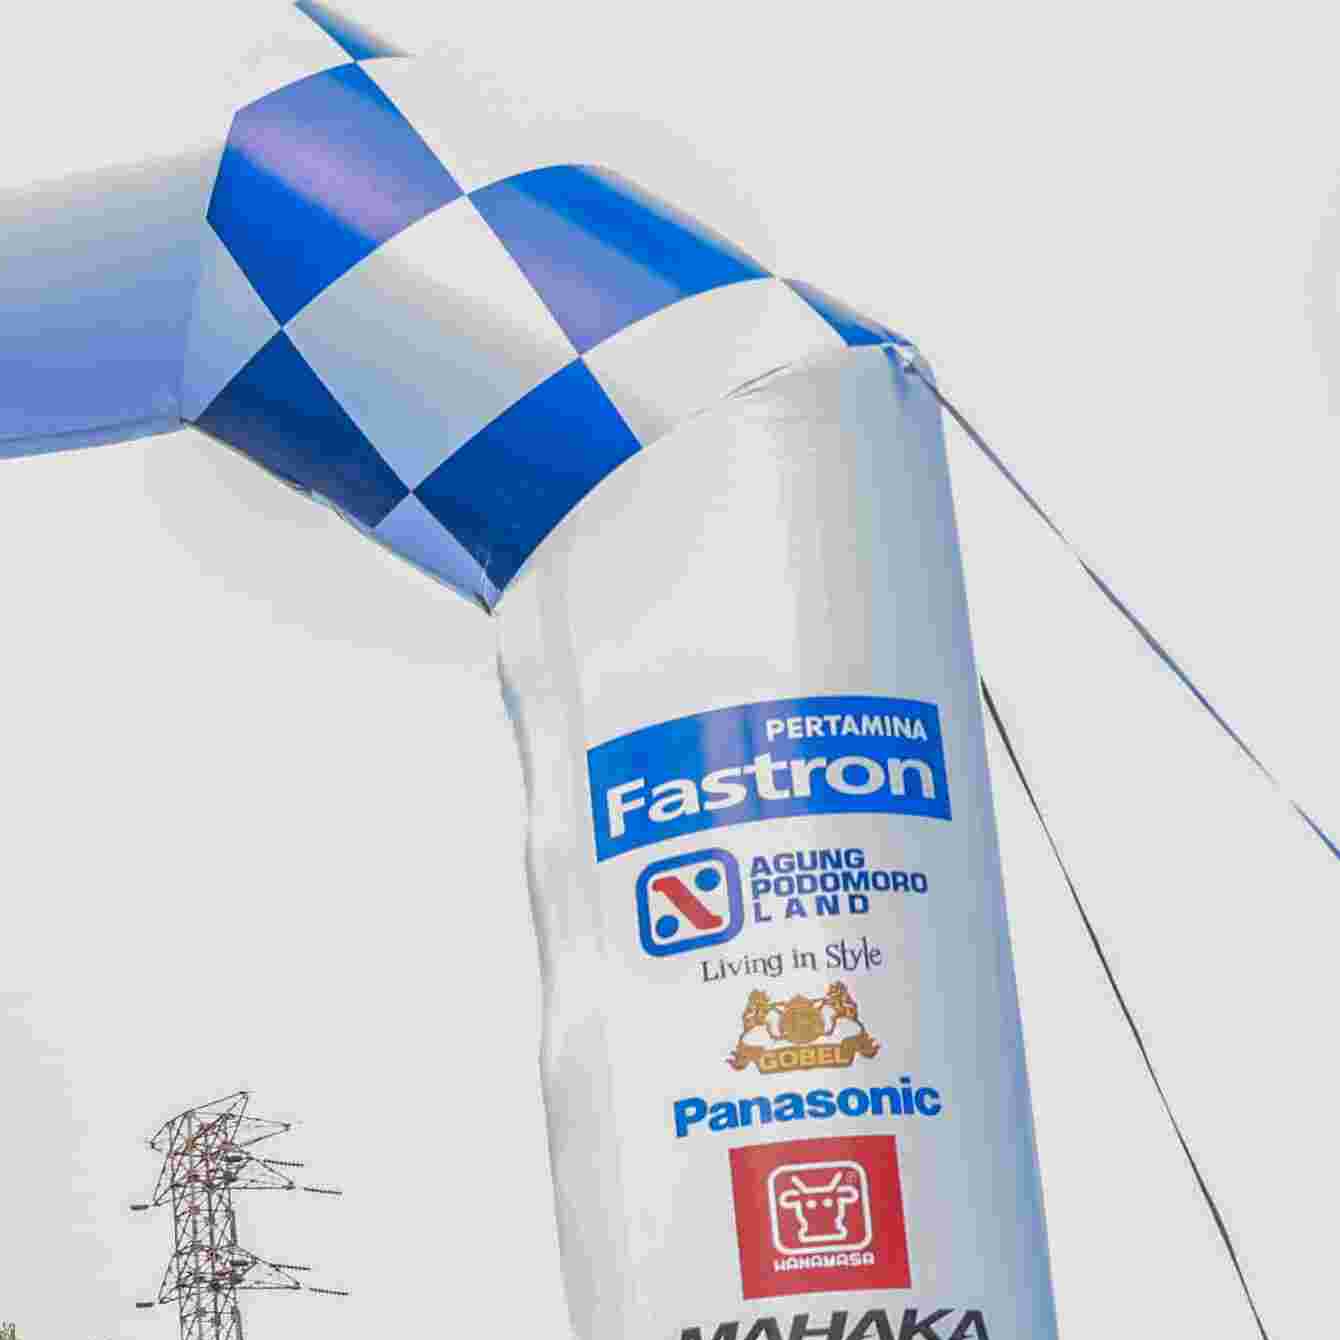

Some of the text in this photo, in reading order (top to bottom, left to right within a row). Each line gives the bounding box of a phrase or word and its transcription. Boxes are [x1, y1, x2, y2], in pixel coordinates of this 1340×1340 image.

[766, 714, 928, 742] PERTAMINA
[606, 753, 936, 840] Fastron
[751, 848, 865, 877] AGUNG
[752, 871, 928, 898] PODOMORO
[753, 894, 869, 922] LAND
[703, 936, 882, 983] Living in Style
[760, 1046, 849, 1071] GOBEL
[673, 1078, 942, 1138] Panasonic
[774, 1252, 874, 1272] HANAMASA
